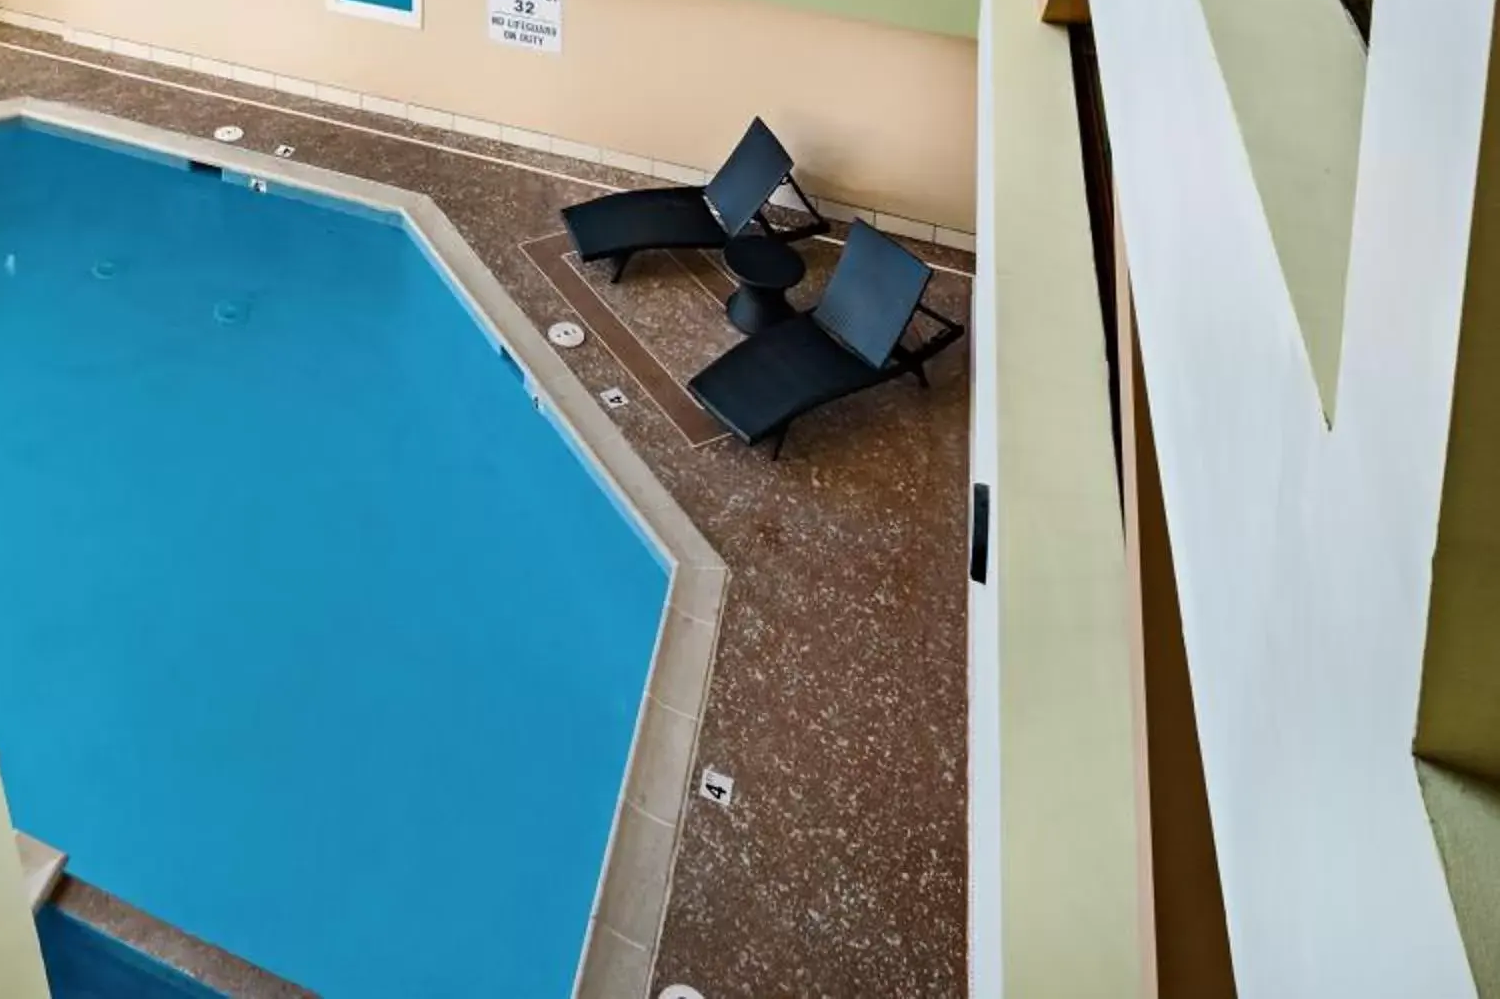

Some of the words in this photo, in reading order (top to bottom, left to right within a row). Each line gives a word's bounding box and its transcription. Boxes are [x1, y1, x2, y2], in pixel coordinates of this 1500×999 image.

[491, 16, 504, 26] NO
[503, 30, 517, 40] ON
[519, 33, 543, 45] DUTY
[705, 783, 727, 800] 4
